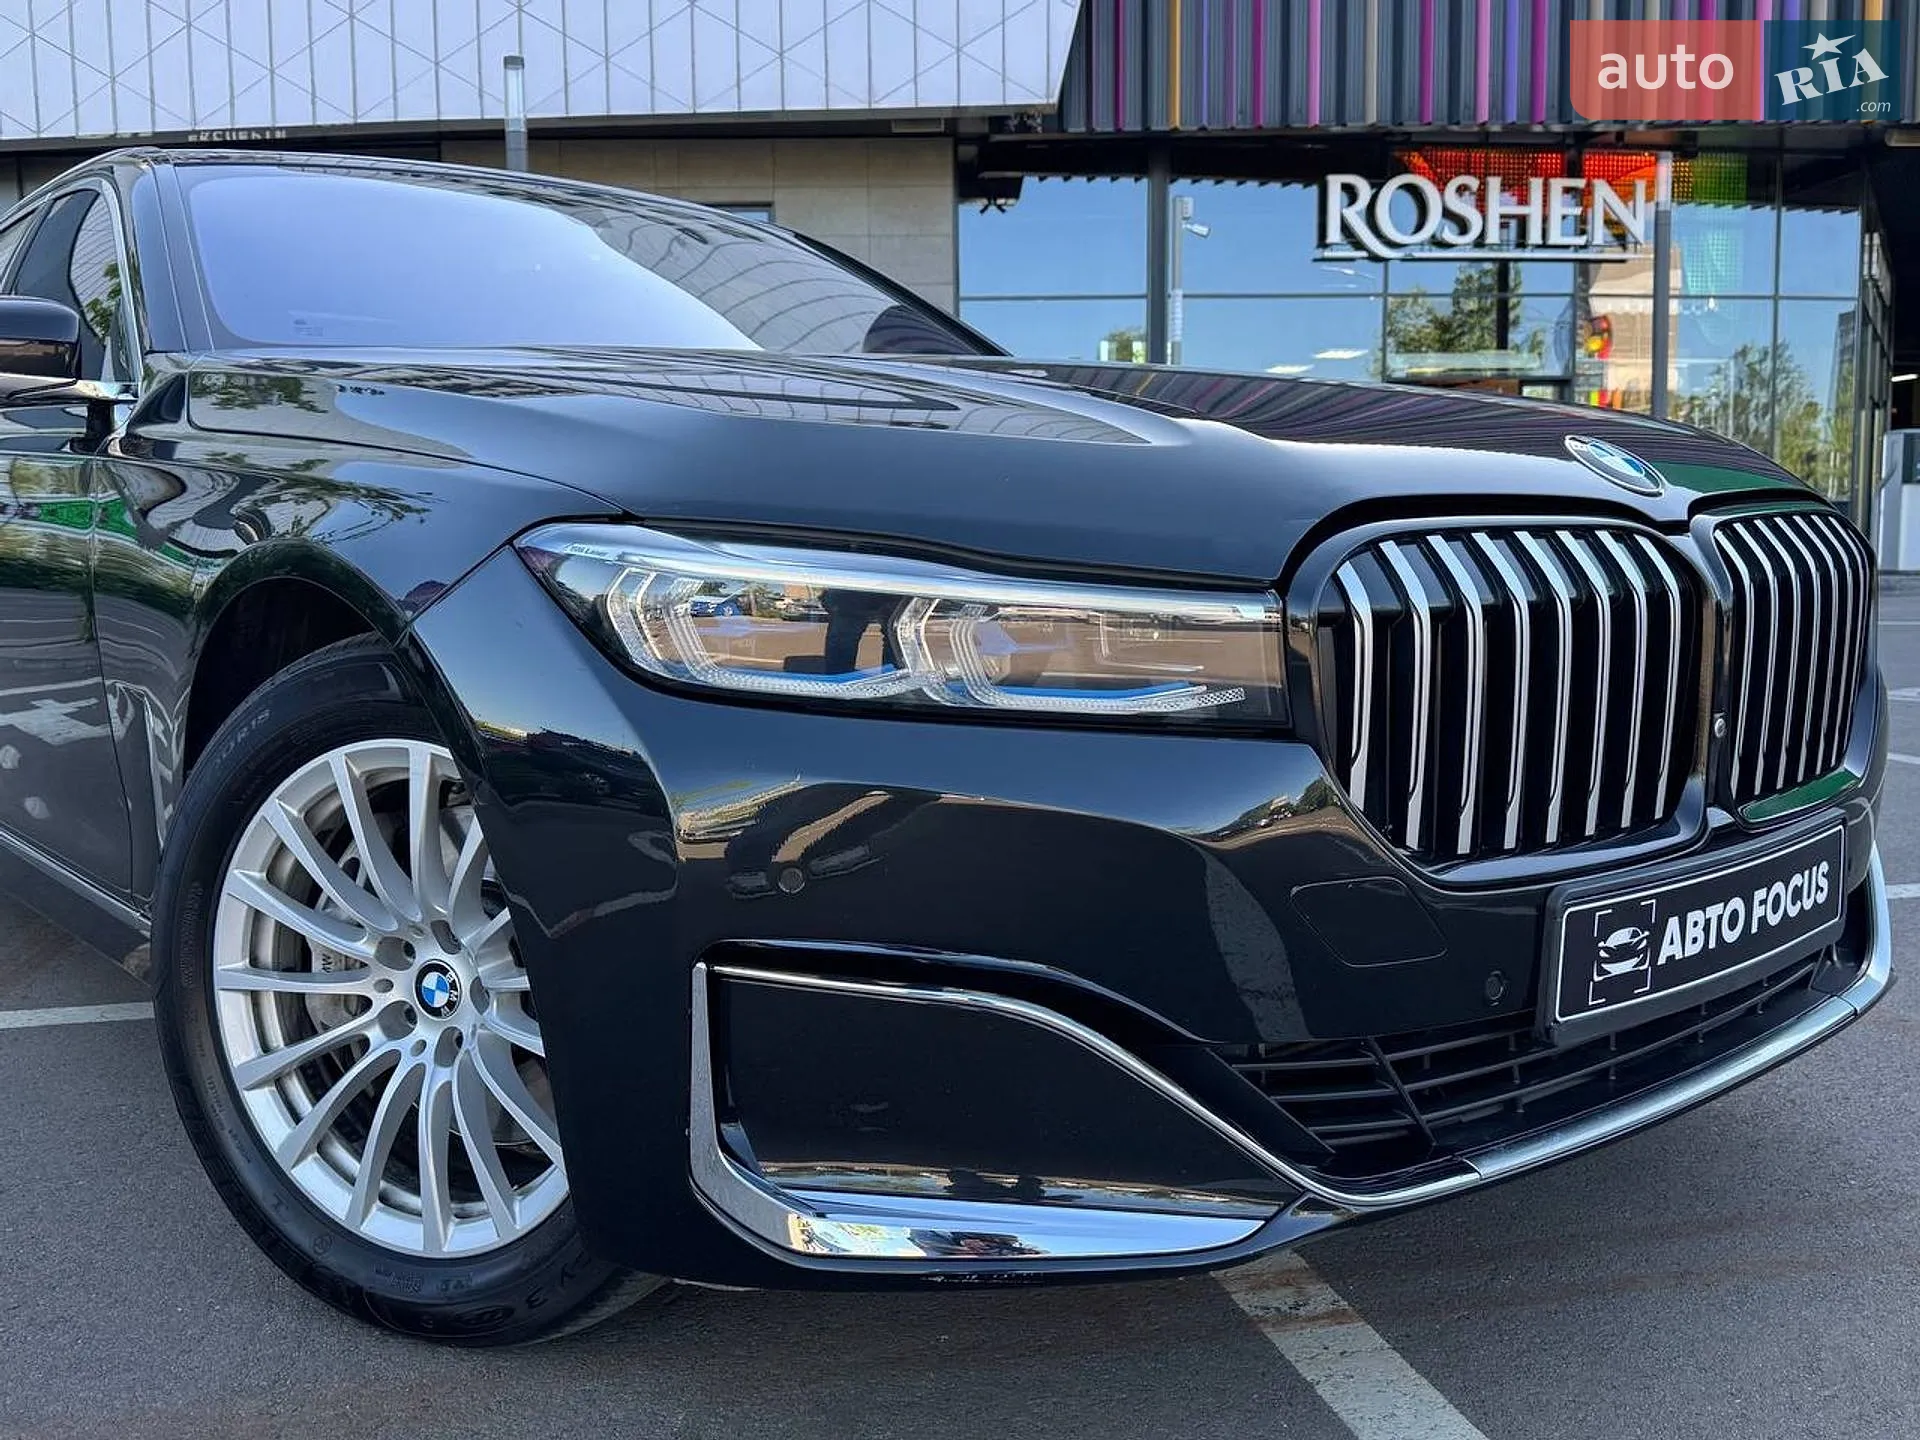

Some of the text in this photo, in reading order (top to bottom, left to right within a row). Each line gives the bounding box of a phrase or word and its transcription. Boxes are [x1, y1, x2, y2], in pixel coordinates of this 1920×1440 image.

[1326, 174, 1647, 258] ROSHEN
[1656, 860, 1829, 965] АВТО FOCUS
